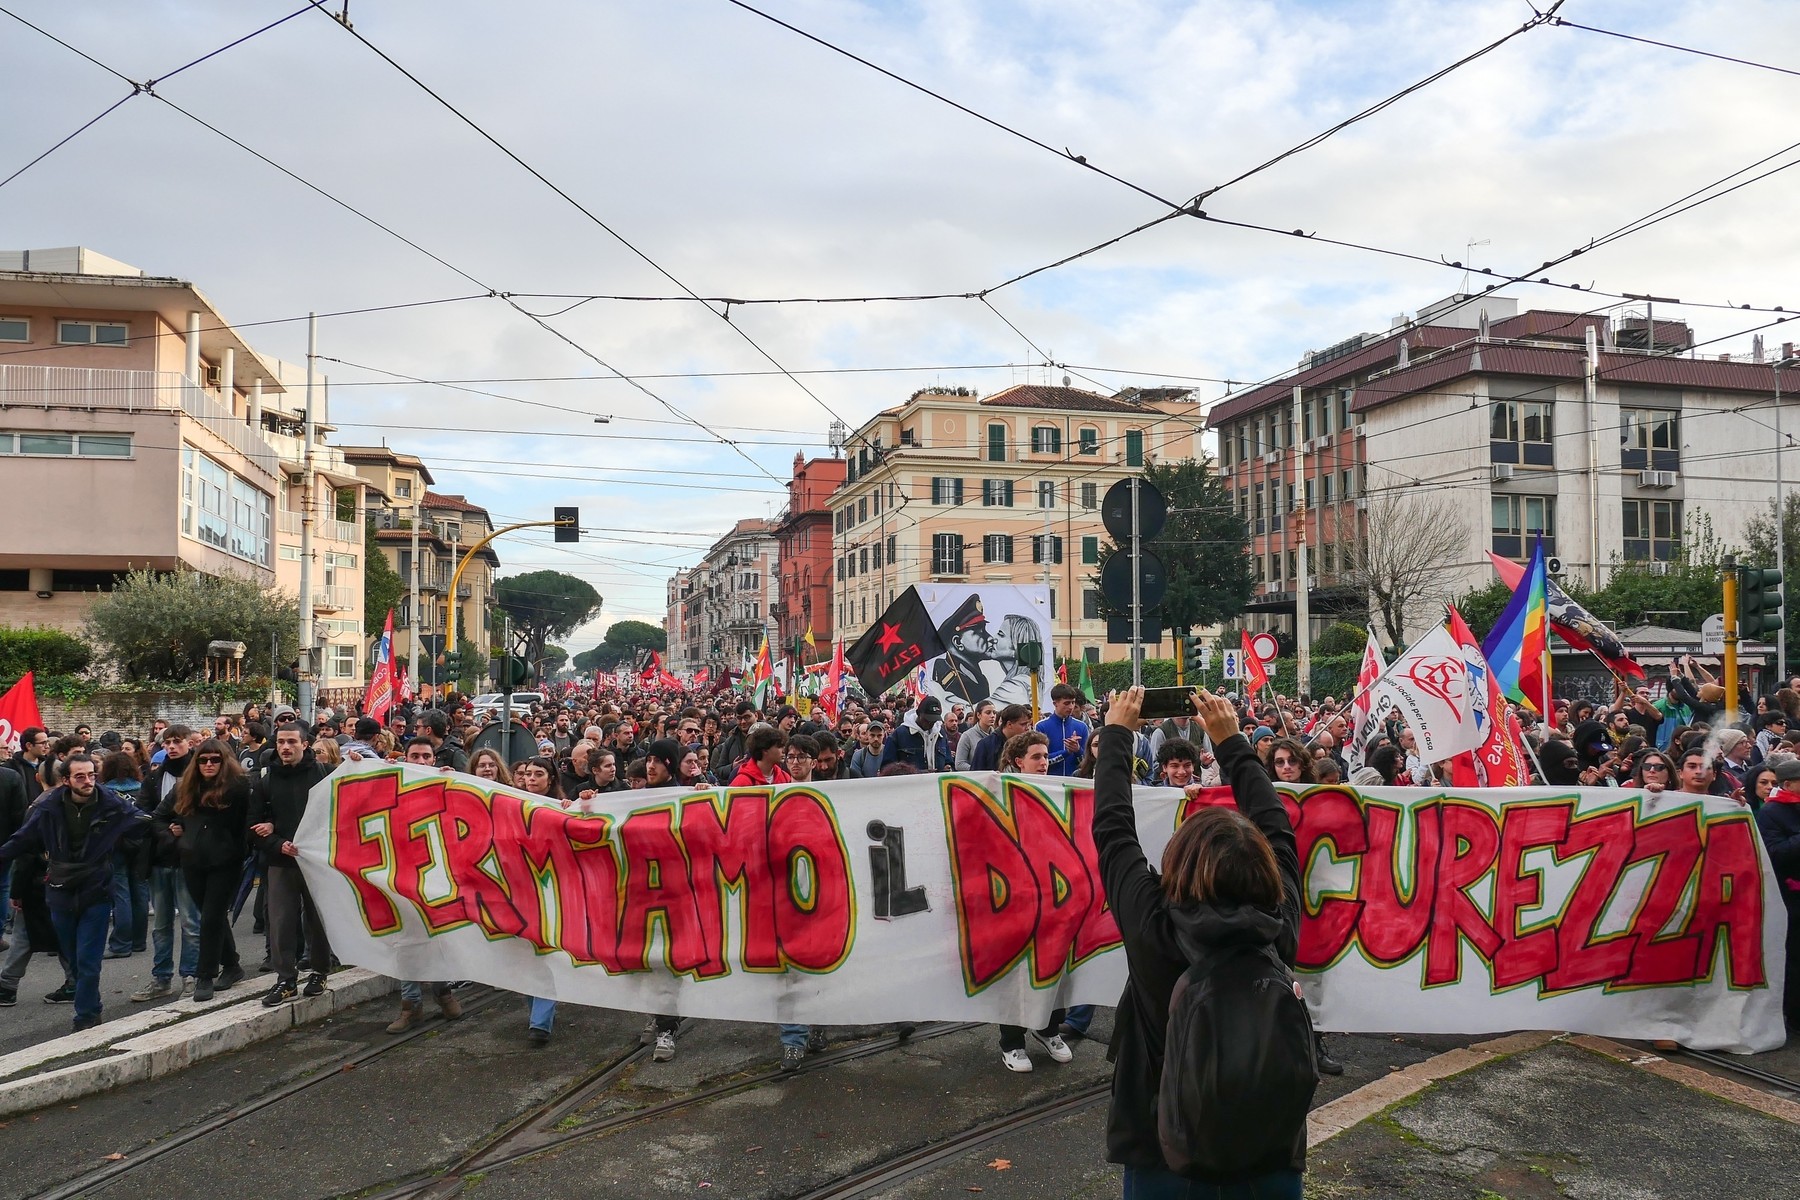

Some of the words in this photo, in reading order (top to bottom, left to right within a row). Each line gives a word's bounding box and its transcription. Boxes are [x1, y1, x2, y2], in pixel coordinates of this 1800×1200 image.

[1412, 707, 1424, 721] per
[1420, 722, 1428, 731] la
[1424, 731, 1434, 751] Casa
[1174, 784, 1769, 1001] CUREZZA
